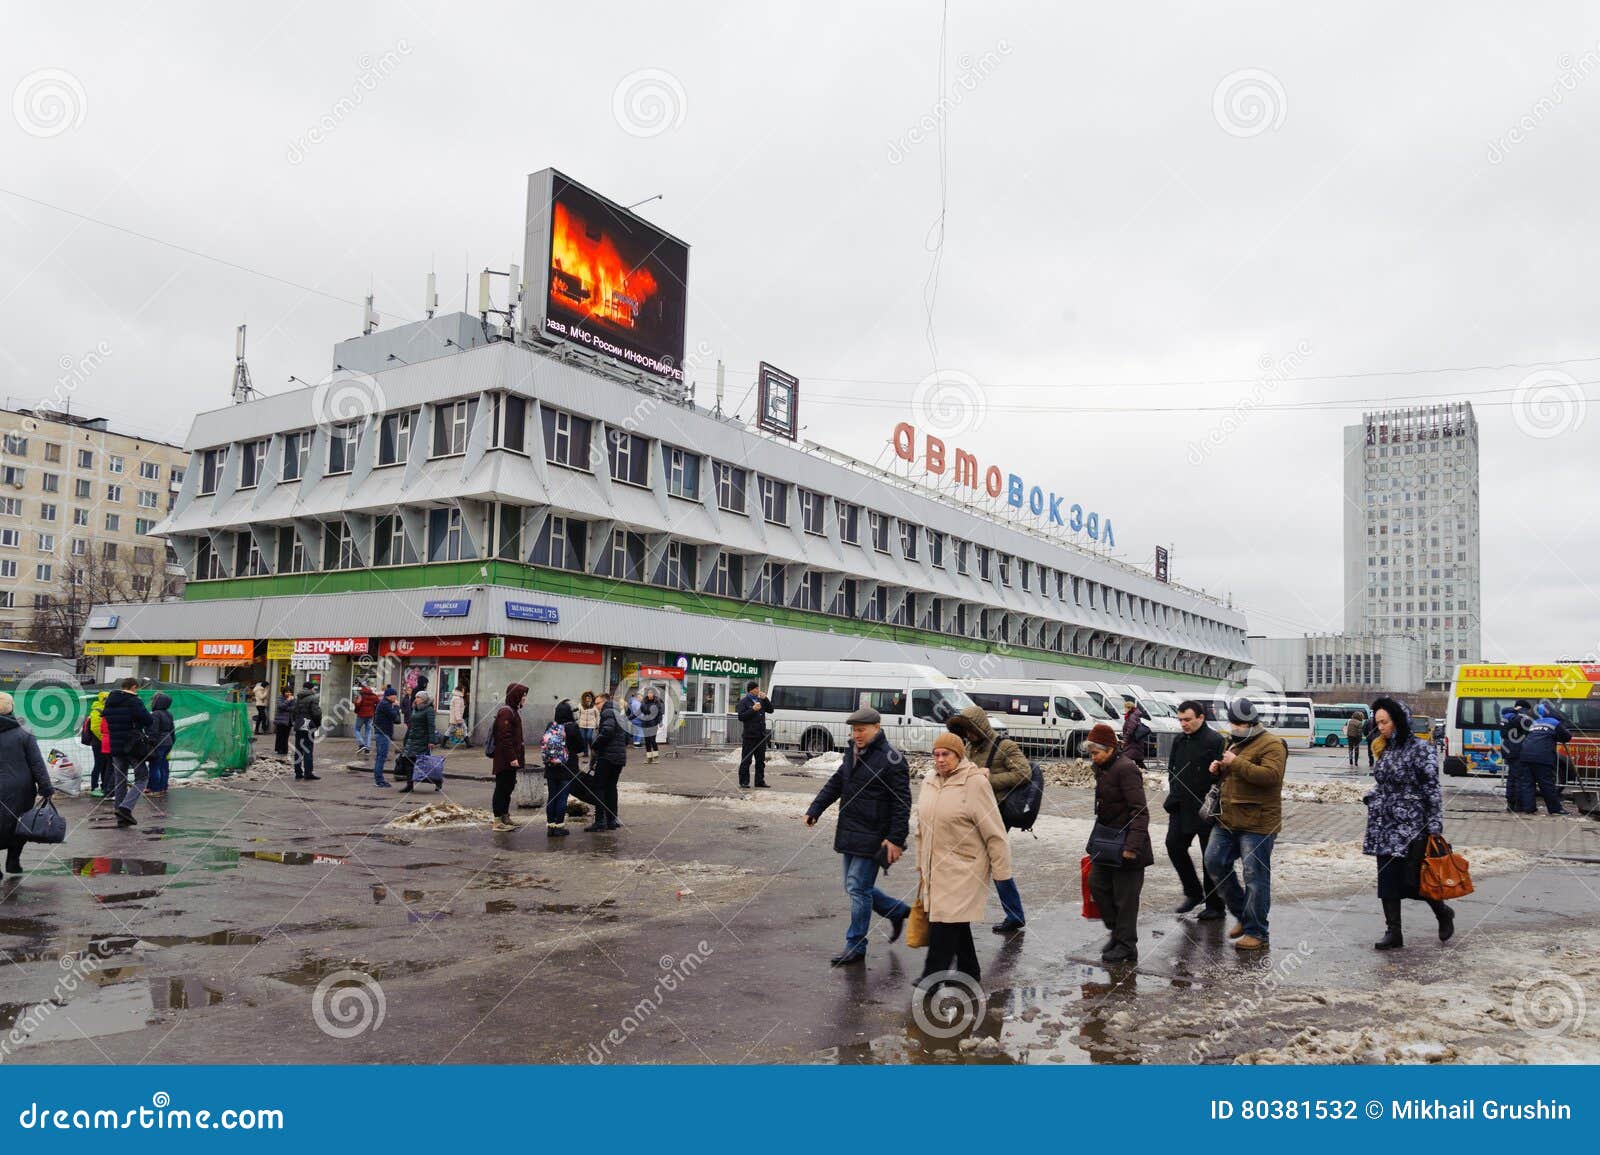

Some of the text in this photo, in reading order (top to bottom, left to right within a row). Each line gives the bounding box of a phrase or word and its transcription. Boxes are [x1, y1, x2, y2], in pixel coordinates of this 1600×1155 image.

[570, 326, 592, 343] МЧС
[593, 335, 623, 357] России
[547, 609, 557, 619] 75
[203, 644, 245, 655] ШАУРМА
[294, 638, 354, 653] ЦВЕТОЧНЫЙ
[510, 643, 528, 653] МТС
[291, 660, 331, 670] РЕМОНТ
